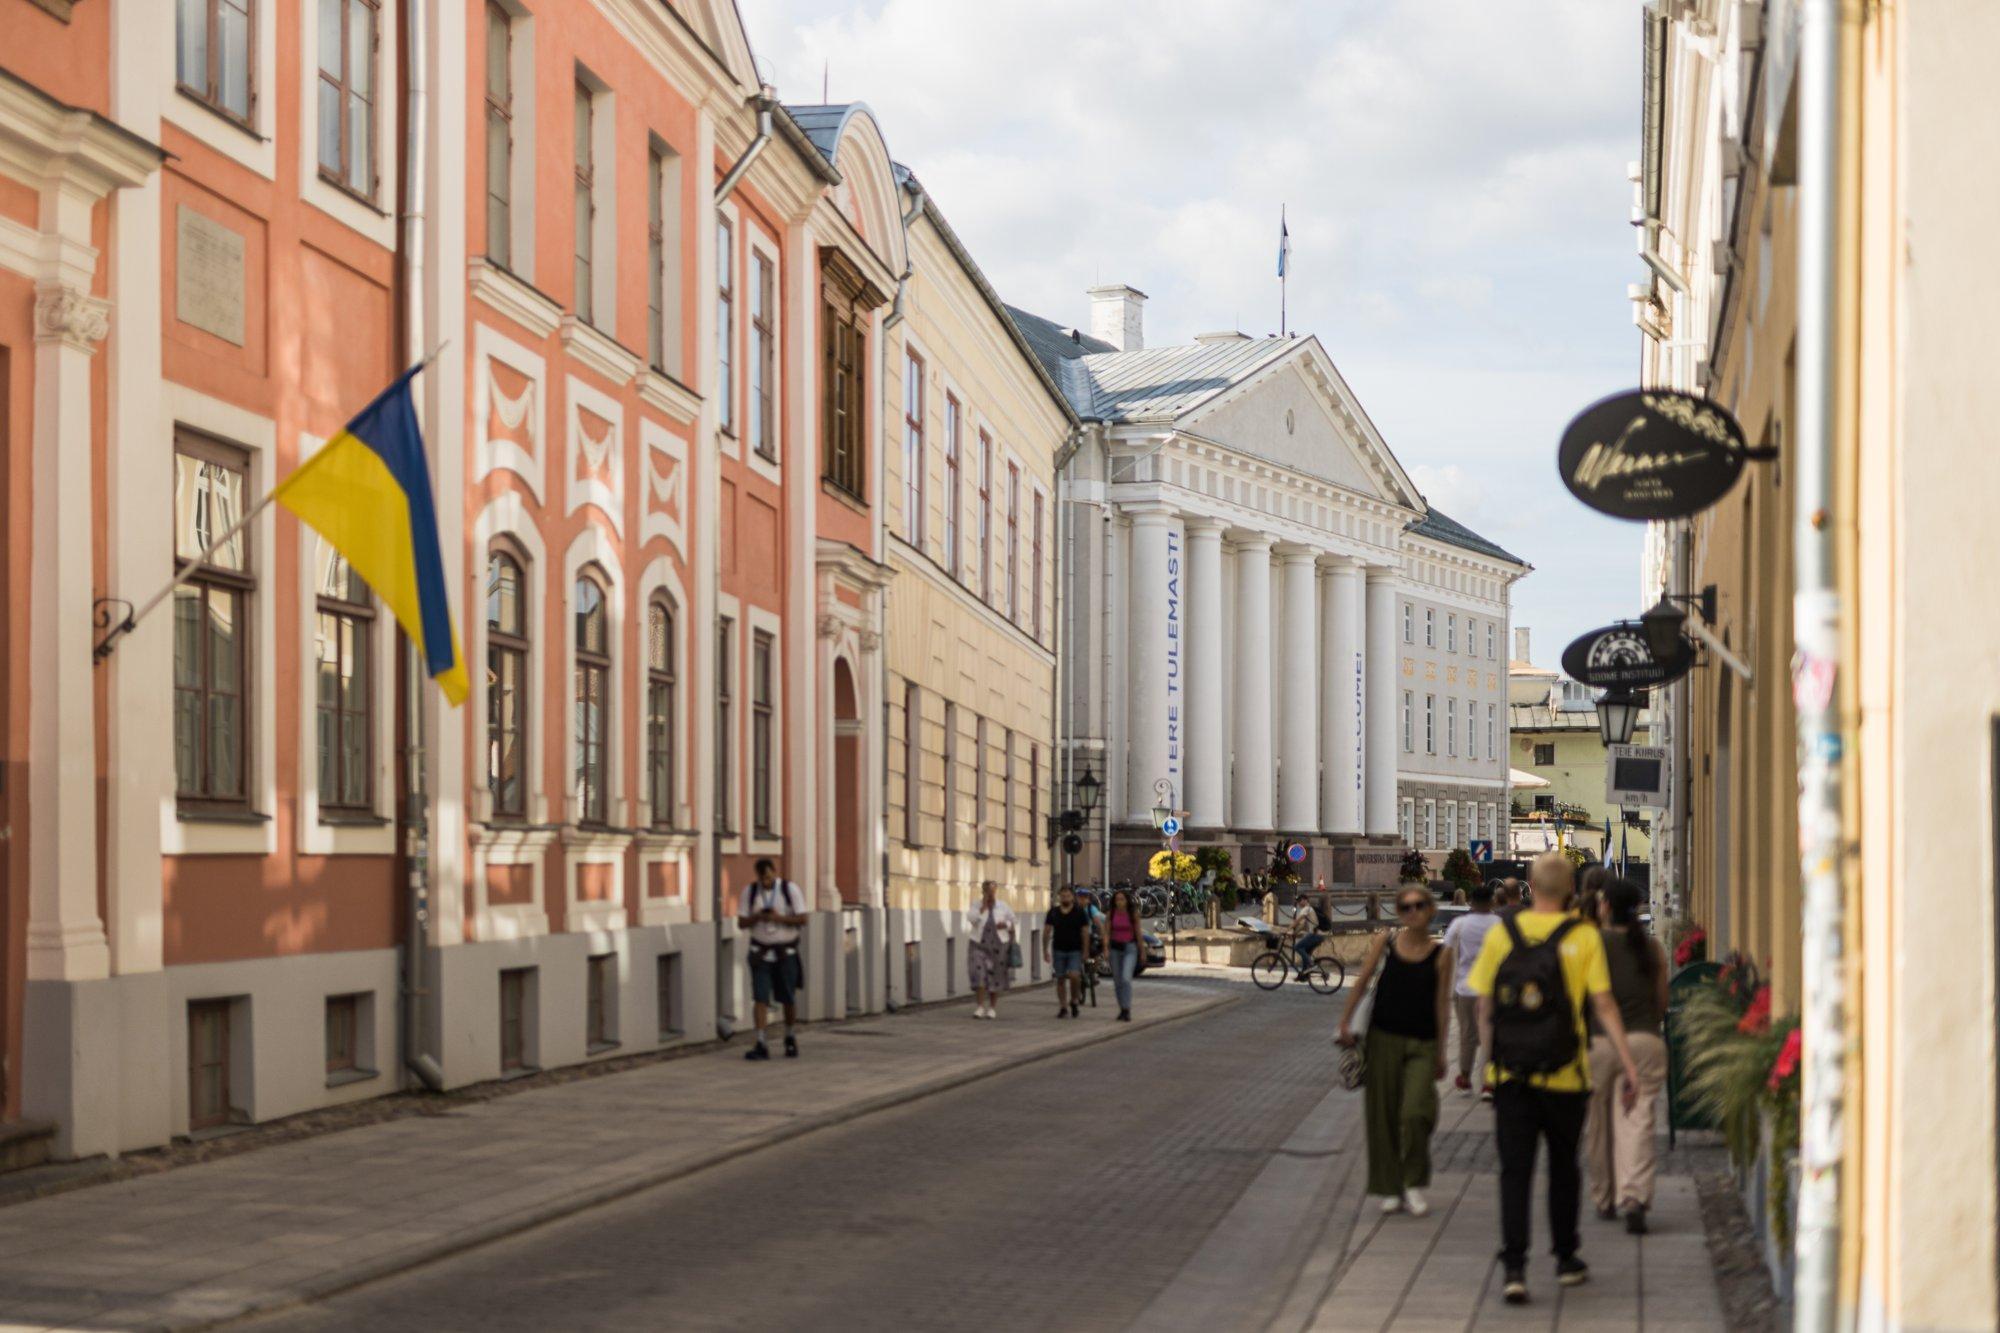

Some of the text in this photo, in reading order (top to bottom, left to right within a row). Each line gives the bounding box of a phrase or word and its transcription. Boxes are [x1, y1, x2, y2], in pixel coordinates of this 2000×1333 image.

[1167, 530, 1179, 773] TERE TULEMAST!
[1614, 746, 1666, 759] TEIE KIIRUS
[1625, 791, 1648, 804] km/h
